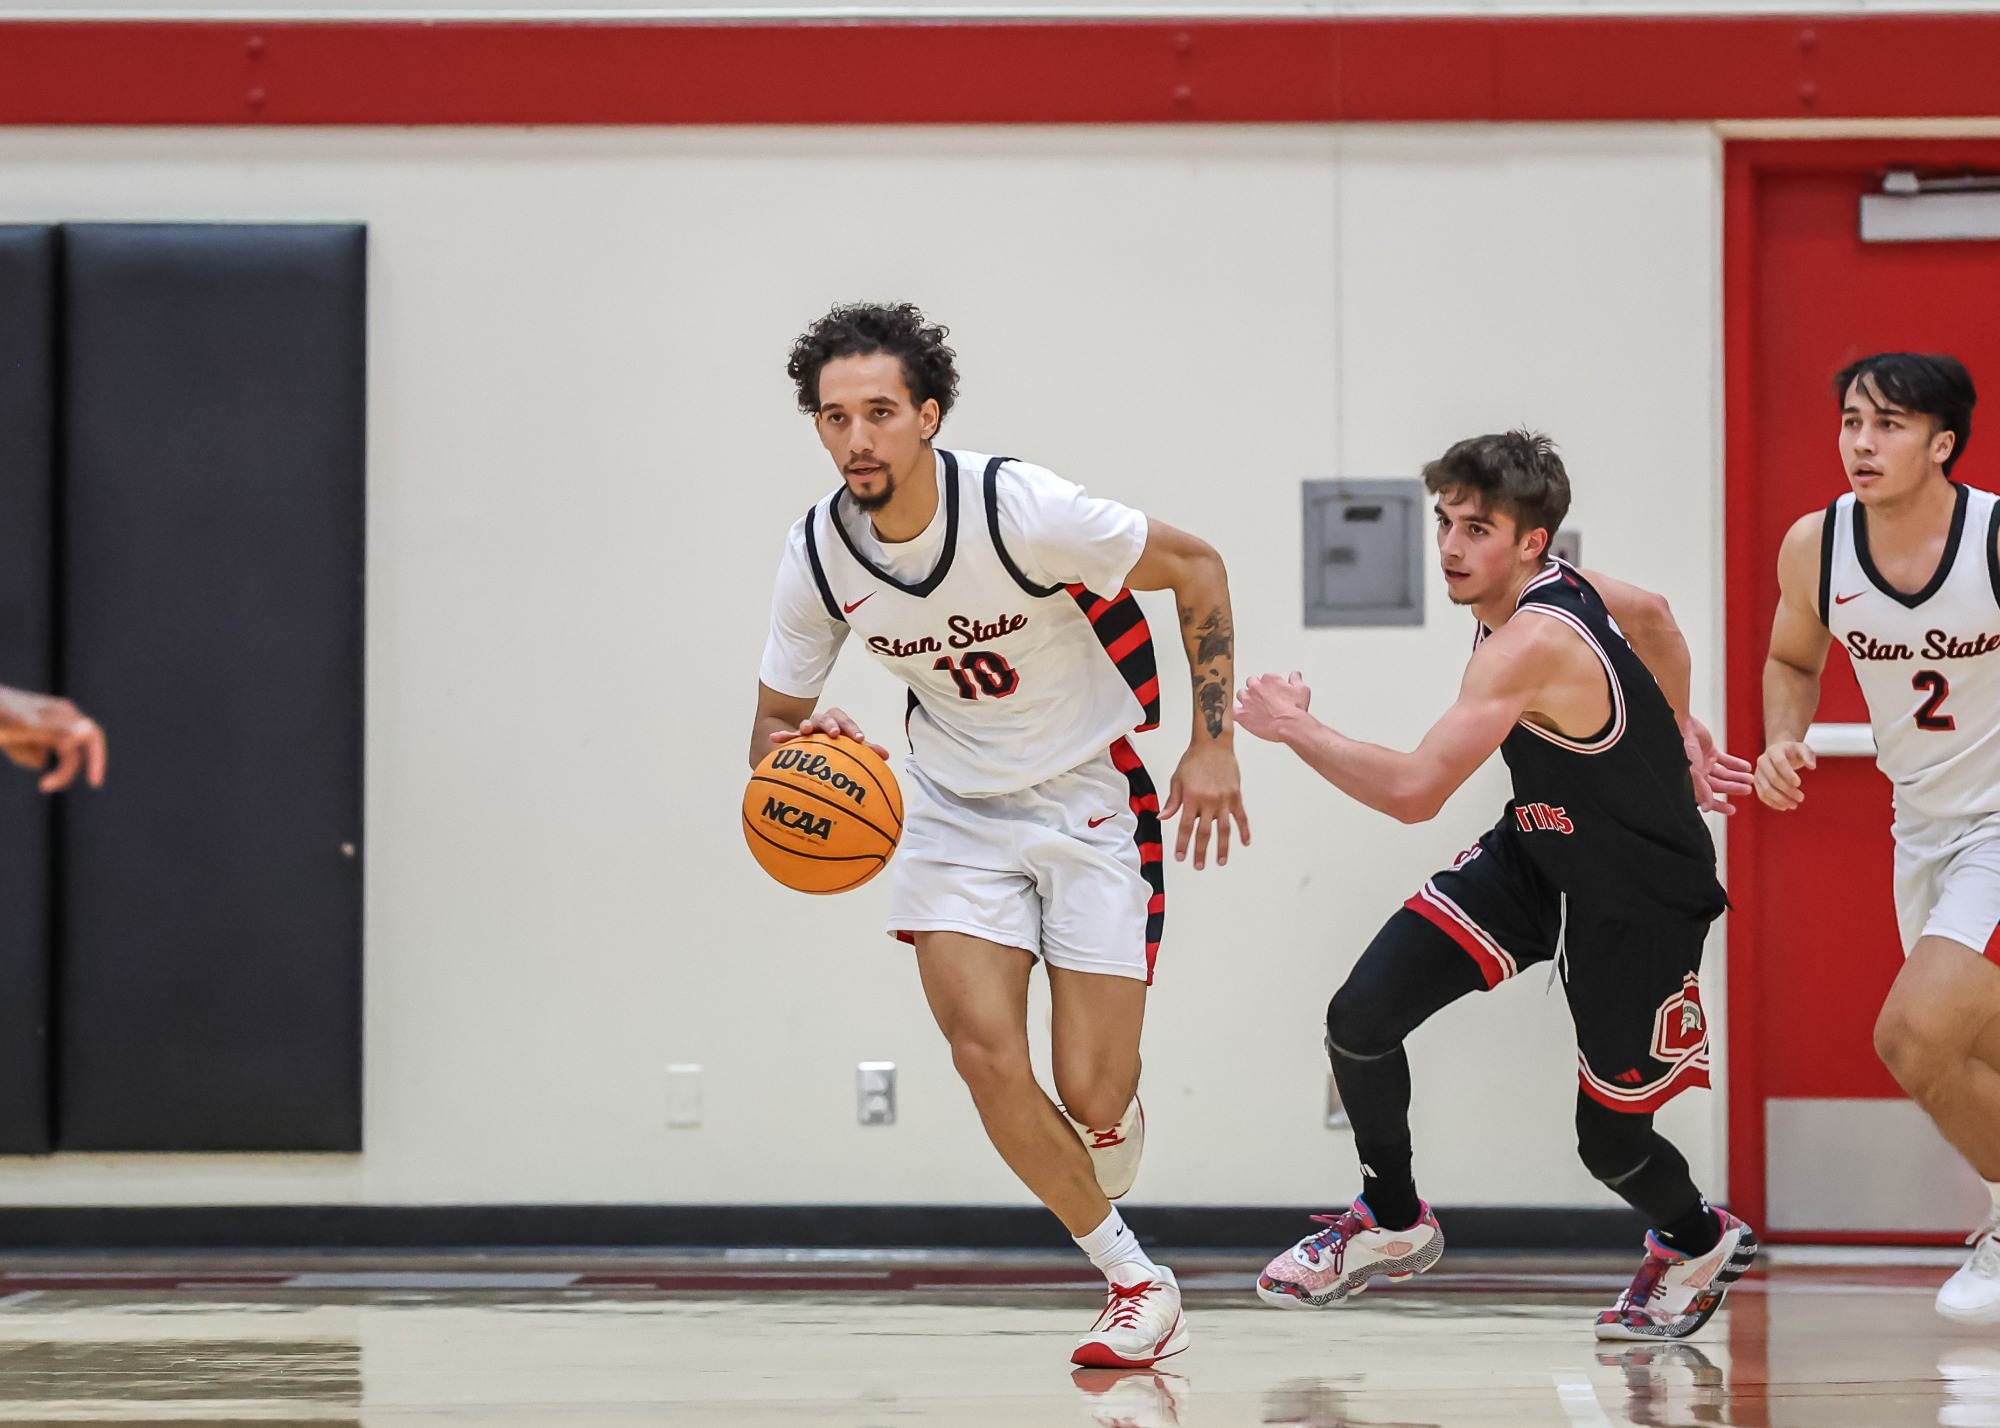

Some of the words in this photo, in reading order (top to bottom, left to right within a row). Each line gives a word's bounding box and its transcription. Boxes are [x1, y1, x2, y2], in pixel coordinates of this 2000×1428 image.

[868, 635, 942, 658] Stan
[947, 613, 1028, 649] State
[1847, 630, 1914, 661] Stan
[1920, 628, 2000, 661] State
[932, 651, 1020, 701] 10
[1911, 669, 1956, 732] 2
[771, 749, 867, 806] Wilson
[761, 796, 833, 841] NCAA
[1514, 802, 1575, 835] TINS
